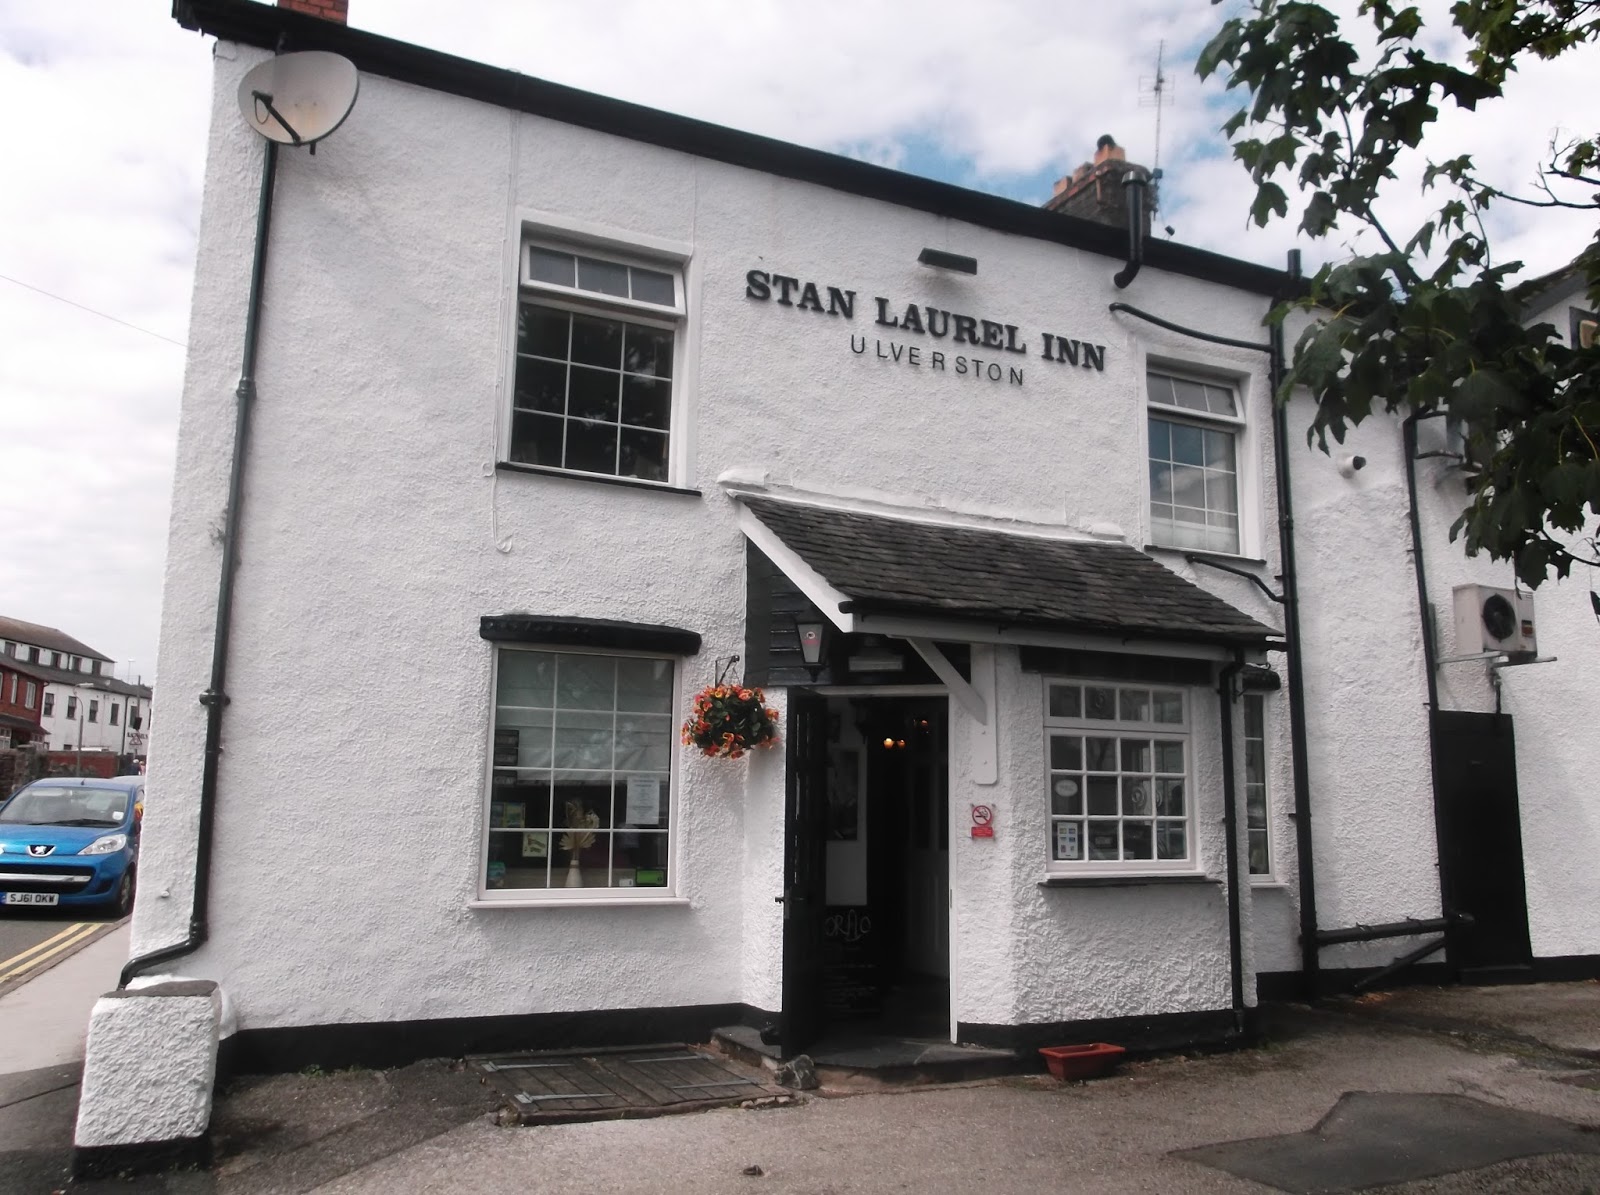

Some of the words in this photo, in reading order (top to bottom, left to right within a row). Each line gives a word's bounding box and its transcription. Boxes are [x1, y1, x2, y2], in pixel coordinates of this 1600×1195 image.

[746, 269, 857, 320] STAN
[874, 296, 1028, 355] LAUREL
[1041, 332, 1107, 373] INN
[851, 334, 1024, 386] ULVERSTON
[10, 893, 33, 903] SJ61
